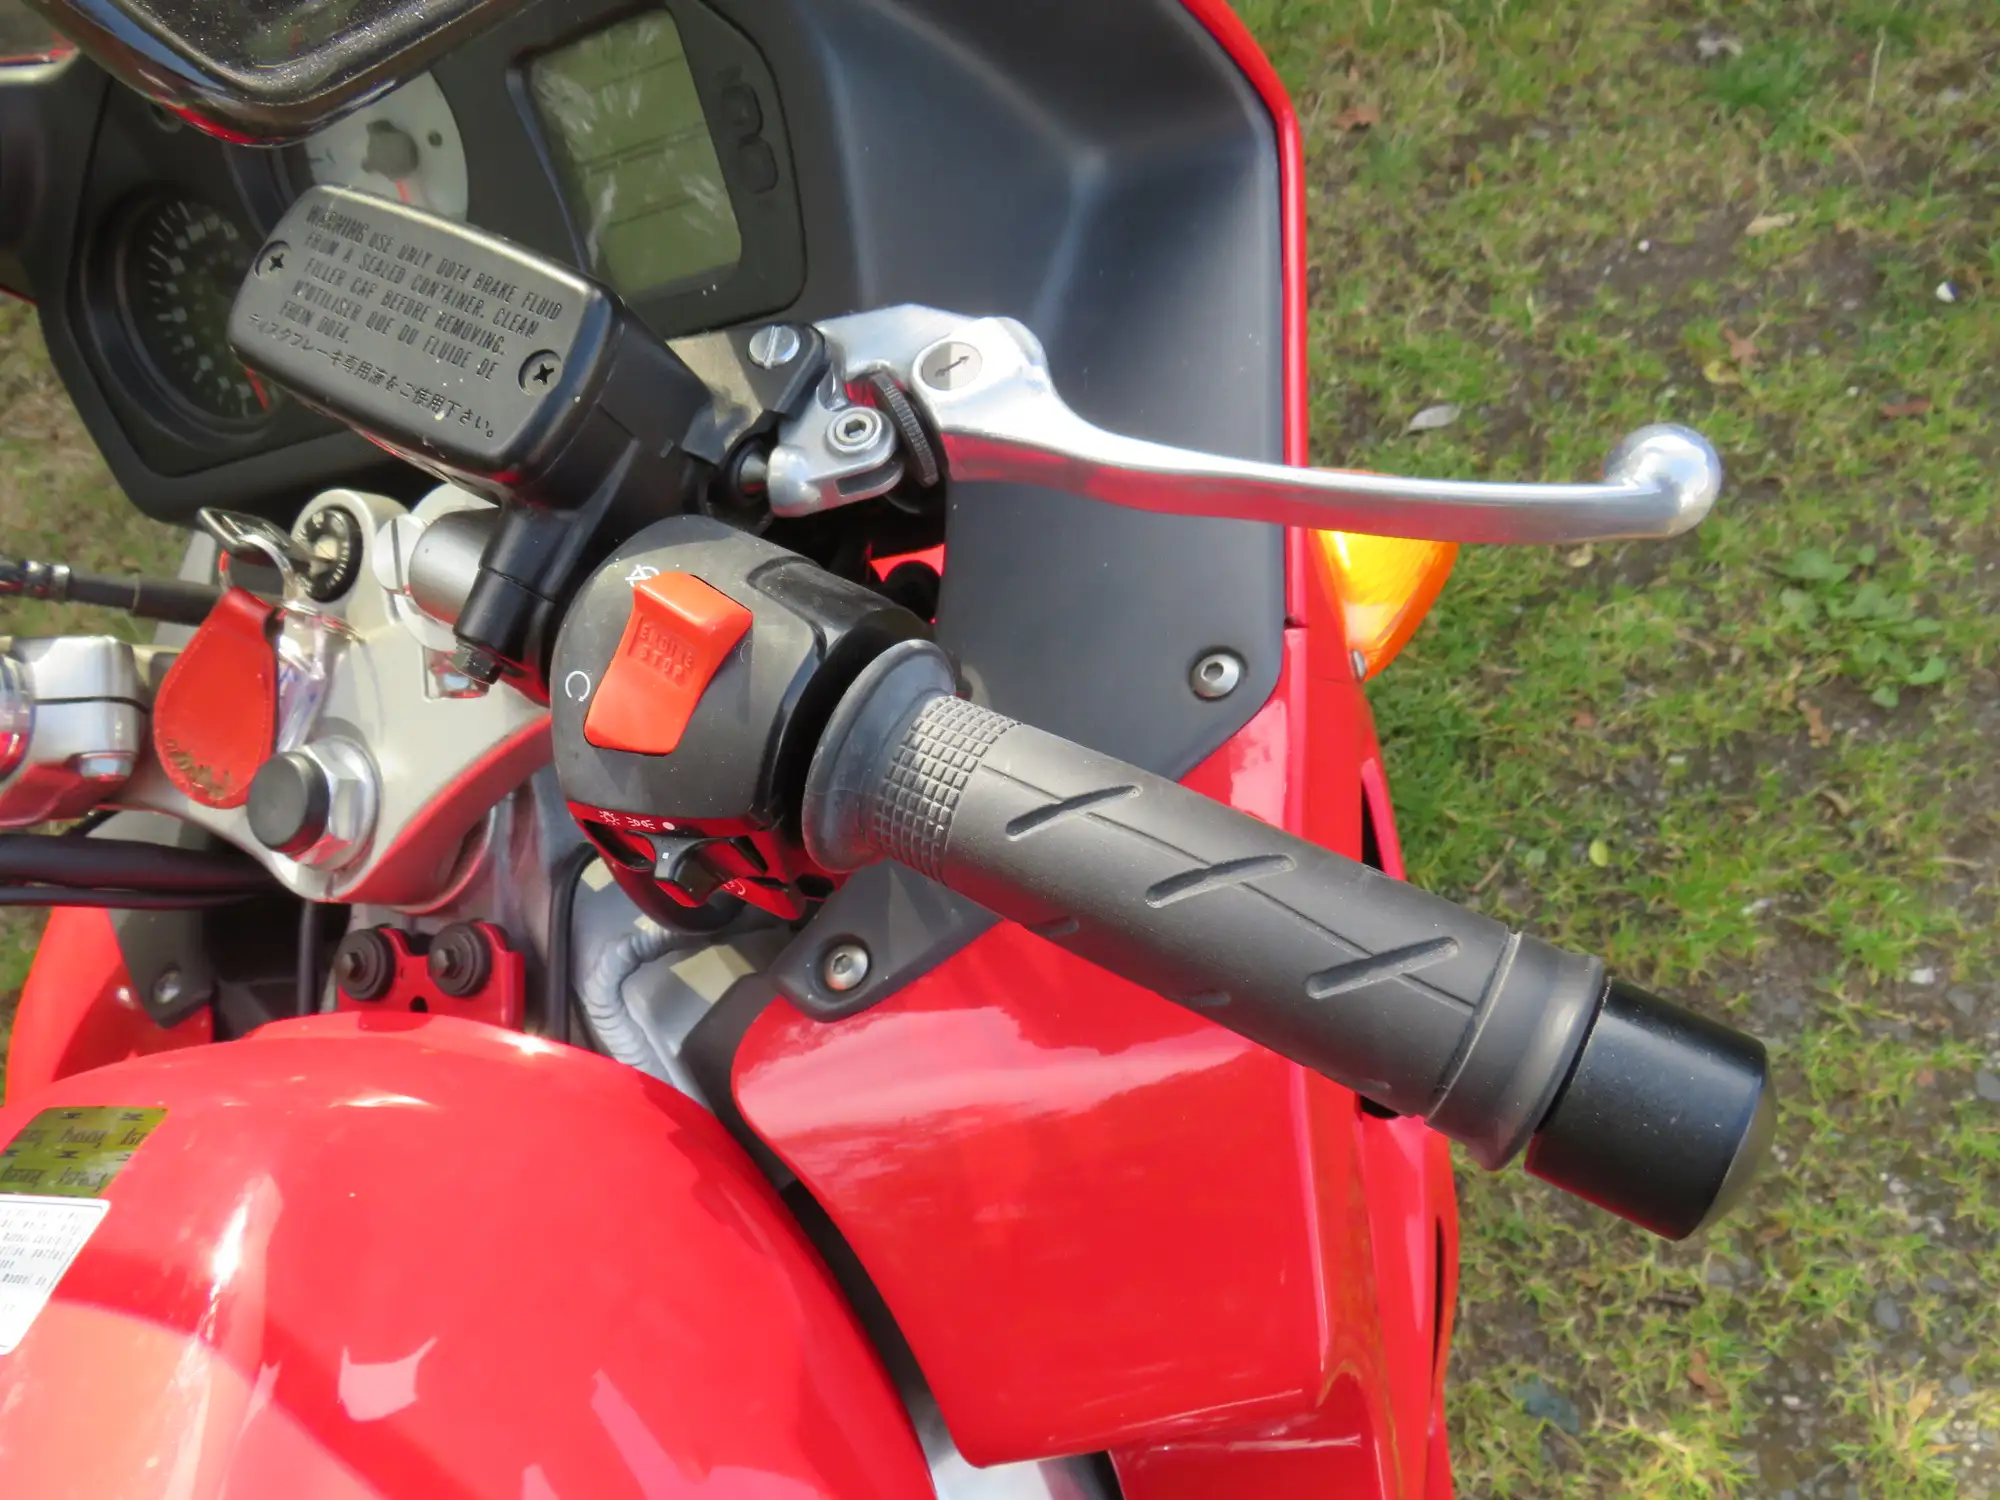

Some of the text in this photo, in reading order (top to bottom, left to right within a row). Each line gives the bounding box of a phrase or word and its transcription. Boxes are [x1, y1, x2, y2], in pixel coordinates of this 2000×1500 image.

[304, 231, 340, 257] FROM
[358, 252, 406, 285] SEALED
[410, 274, 485, 320] CONTAINER.
[492, 307, 540, 339] CLEAN
[304, 257, 506, 357] FILLER CAP BEFORE REMOVING.
[368, 232, 395, 255] USE
[397, 243, 433, 269] ONLY
[472, 272, 519, 305] BRAKE
[521, 291, 563, 321] FLUID
[365, 310, 397, 336] QUE
[397, 323, 420, 346] DU
[421, 335, 473, 369] FLUIDE
[475, 358, 500, 381] DE
